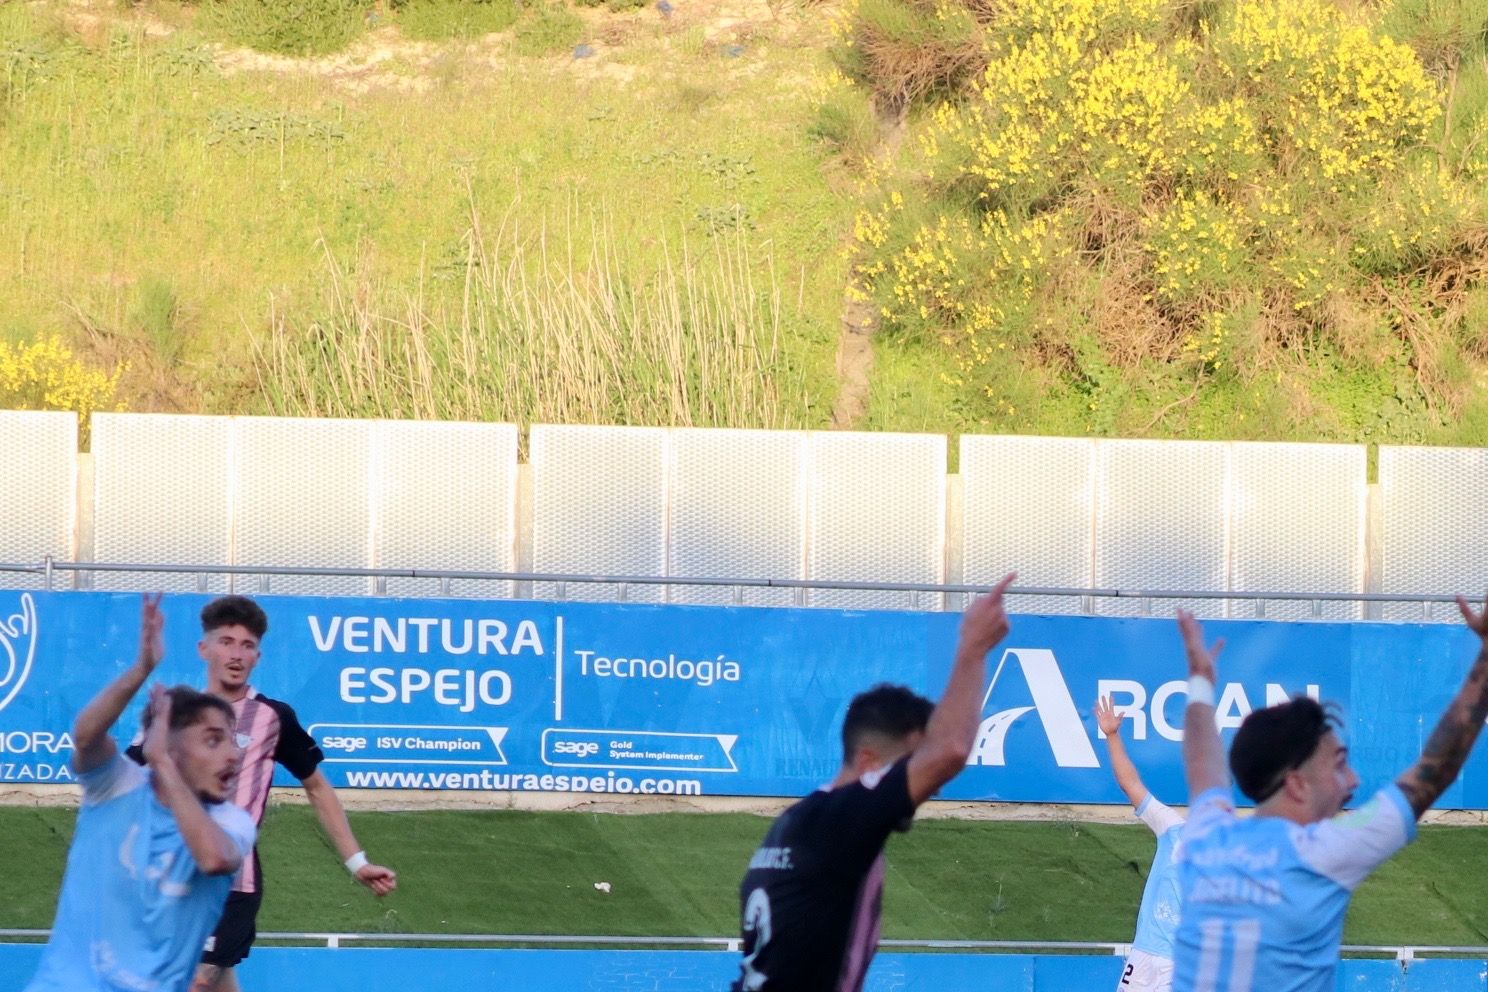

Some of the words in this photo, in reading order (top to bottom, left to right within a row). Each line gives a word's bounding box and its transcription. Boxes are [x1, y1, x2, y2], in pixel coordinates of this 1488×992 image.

[307, 615, 545, 656] VENTURA
[574, 650, 740, 686] Tecnología
[339, 667, 512, 713] ESPEJO
[322, 736, 367, 752] sage
[377, 737, 402, 749] ISV
[405, 737, 481, 752] Champion
[554, 741, 599, 757] sage
[610, 740, 633, 749] Gold
[610, 750, 644, 760] System
[646, 751, 704, 761] Implementer
